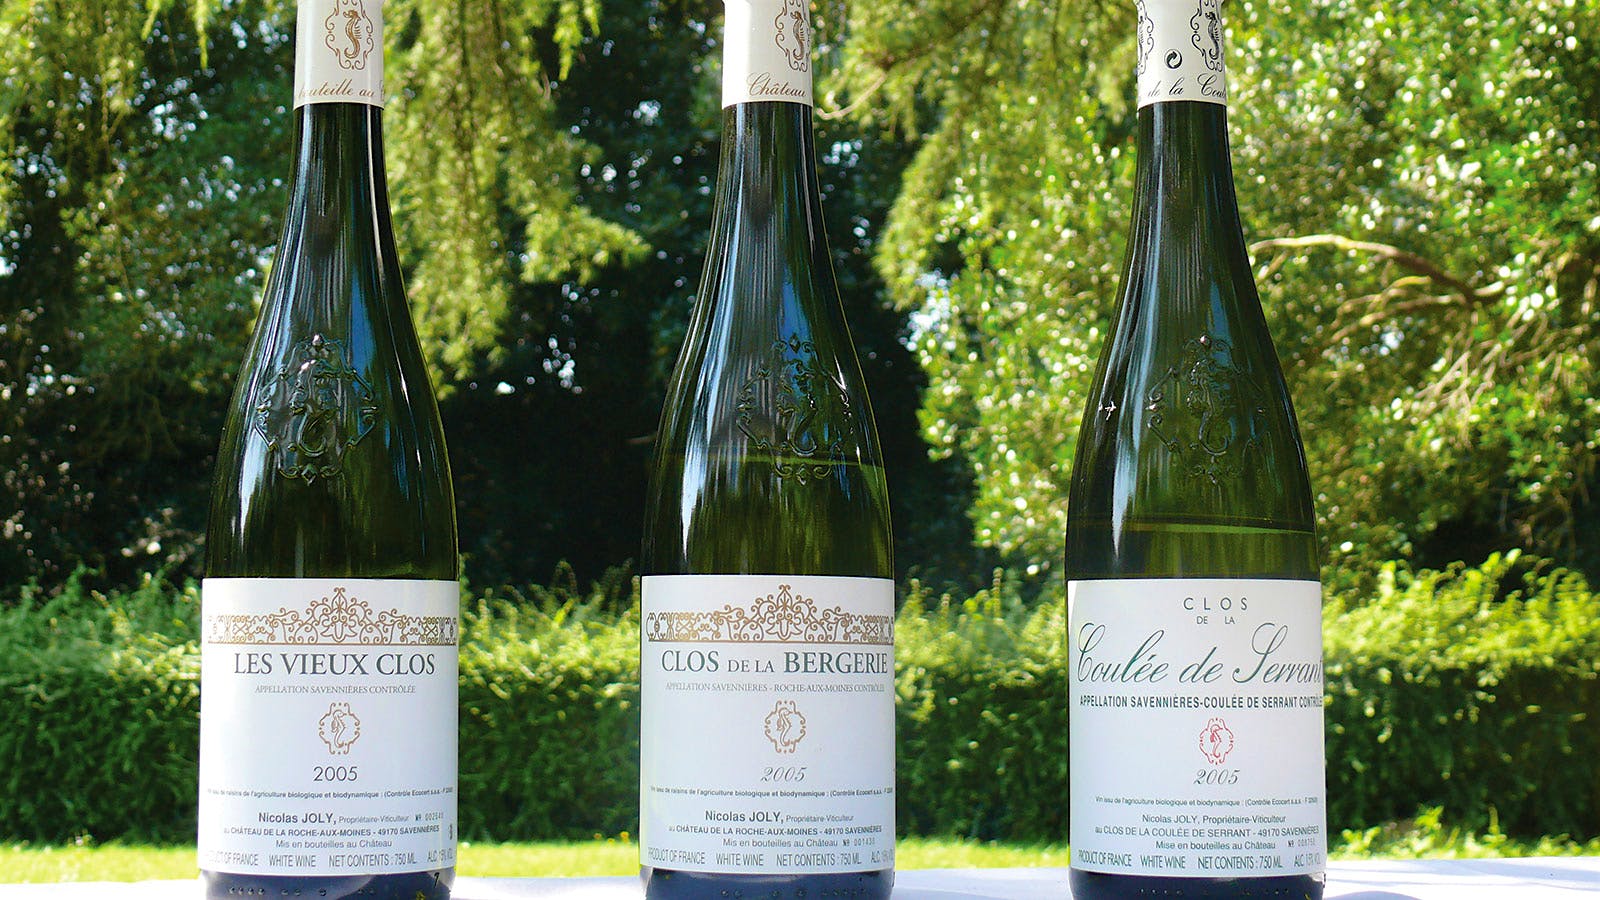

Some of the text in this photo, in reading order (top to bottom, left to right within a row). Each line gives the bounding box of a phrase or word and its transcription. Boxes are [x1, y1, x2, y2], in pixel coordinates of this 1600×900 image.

[746, 71, 807, 98] Château
[1168, 76, 1185, 96] la
[1183, 597, 1248, 611] CLOS
[1196, 615, 1236, 625] DE LA
[1077, 622, 1170, 683] Coulée
[1178, 646, 1224, 683] de
[234, 652, 436, 676] LES VIEUX CLOS
[662, 650, 888, 674] CLOS DE LA BERGERIE
[255, 684, 310, 695] APPELLATION
[369, 683, 417, 695] CONTRÔLÉE
[1080, 695, 1128, 708] APPELLATION
[1130, 693, 1244, 709] SAVENNIÈRES-COULÉE
[1247, 696, 1260, 708] DE
[1262, 696, 1298, 708] SERRANT
[313, 766, 359, 782] 2005
[760, 766, 807, 782] 2005
[1193, 769, 1240, 785] 2005
[259, 812, 299, 823] Nicolas
[301, 812, 337, 825] JOLY,
[705, 810, 746, 822] Nicolas
[749, 811, 784, 825] JOLY,
[1142, 814, 1172, 823] Nicolas
[1173, 814, 1200, 825] JOLY,
[231, 826, 262, 836] CHÂTEAU
[264, 828, 274, 836] DE
[276, 828, 286, 836] LA
[288, 828, 371, 837] ROCHE-AUX-MOINES
[378, 828, 398, 836] 49170
[676, 825, 709, 834] CHÂTEAU
[710, 827, 721, 835] DE
[735, 827, 818, 837] ROCHE-AUX-MOINES
[824, 828, 843, 836] 49170
[1103, 826, 1124, 836] CLOS
[1126, 827, 1137, 836] DE
[1139, 828, 1150, 836] LA
[1152, 827, 1189, 838] COULÉE
[1192, 828, 1204, 838] DE
[1207, 828, 1251, 838] SERRANT
[1257, 828, 1280, 837] 49170
[276, 840, 289, 848] Mis
[305, 840, 344, 848] bouteilles
[360, 839, 392, 848] Château
[723, 838, 737, 847] Mis
[752, 839, 791, 848] bouteilles
[793, 840, 804, 848] au
[806, 838, 838, 848] Château
[1156, 840, 1276, 850] Mise en bouteilles au Château
[269, 854, 293, 867] WHITE
[295, 855, 316, 867] WINE
[329, 855, 345, 867] NET
[347, 854, 389, 867] CONTENTS
[679, 851, 706, 865] FRANCE
[716, 853, 740, 866] WHITE
[743, 854, 764, 866] WINE
[776, 853, 793, 866] NET
[794, 853, 836, 867] CONTENTS
[1107, 852, 1132, 867] FRANCE
[1140, 855, 1163, 869] WHITE
[1165, 856, 1186, 869] WINE
[1198, 856, 1213, 869] NET
[1215, 855, 1254, 870] CONTENTS
